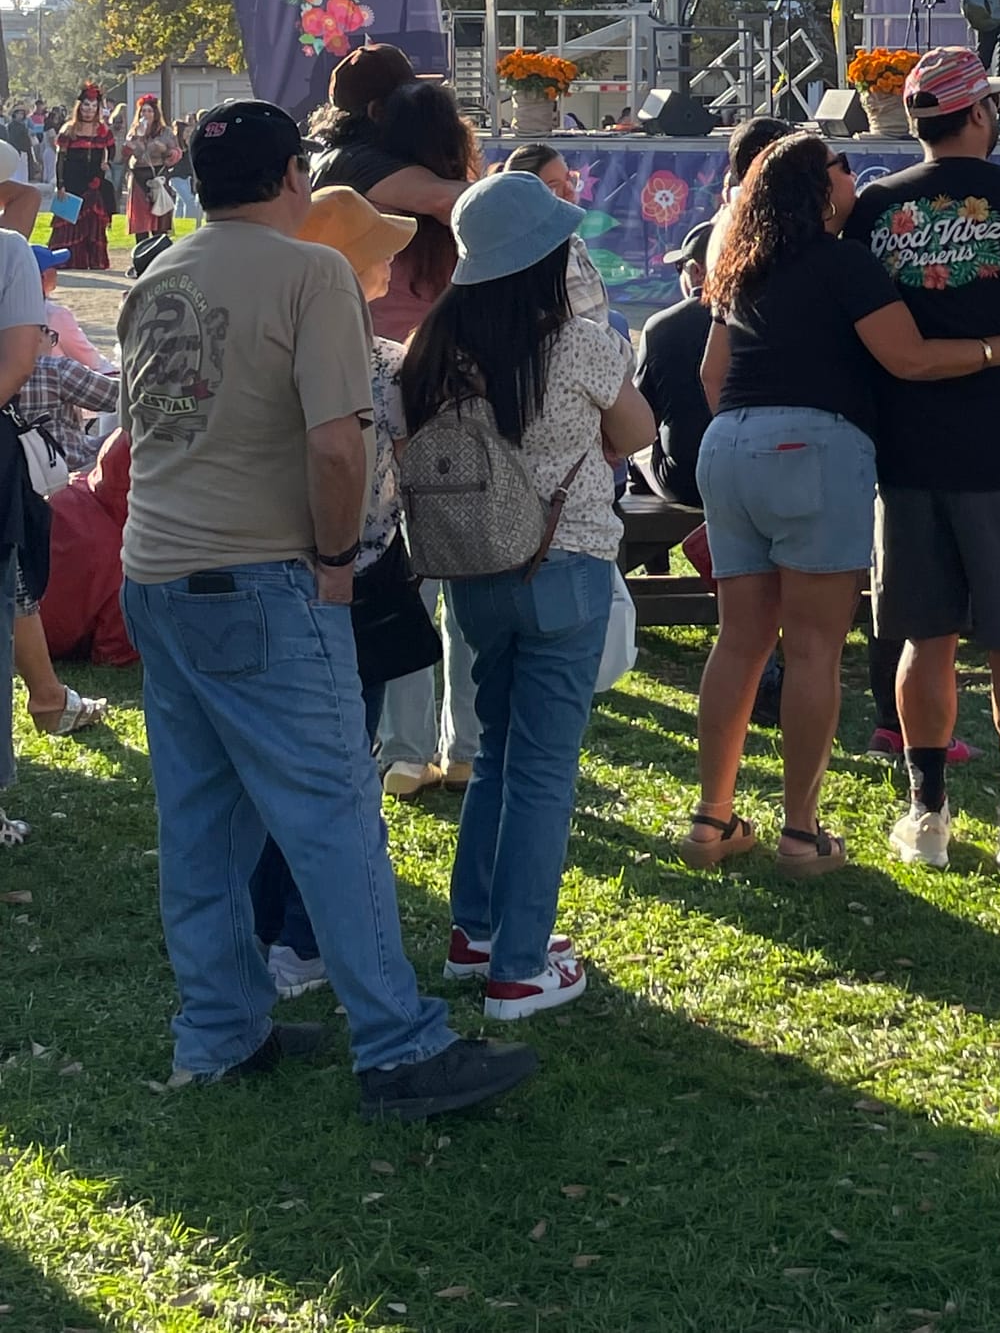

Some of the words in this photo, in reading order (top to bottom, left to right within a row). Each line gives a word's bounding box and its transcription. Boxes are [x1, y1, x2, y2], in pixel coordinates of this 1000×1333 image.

[870, 222, 933, 258] Good
[894, 244, 977, 270] Presents
[145, 277, 178, 302] LONG
[178, 274, 209, 313] BEACH
